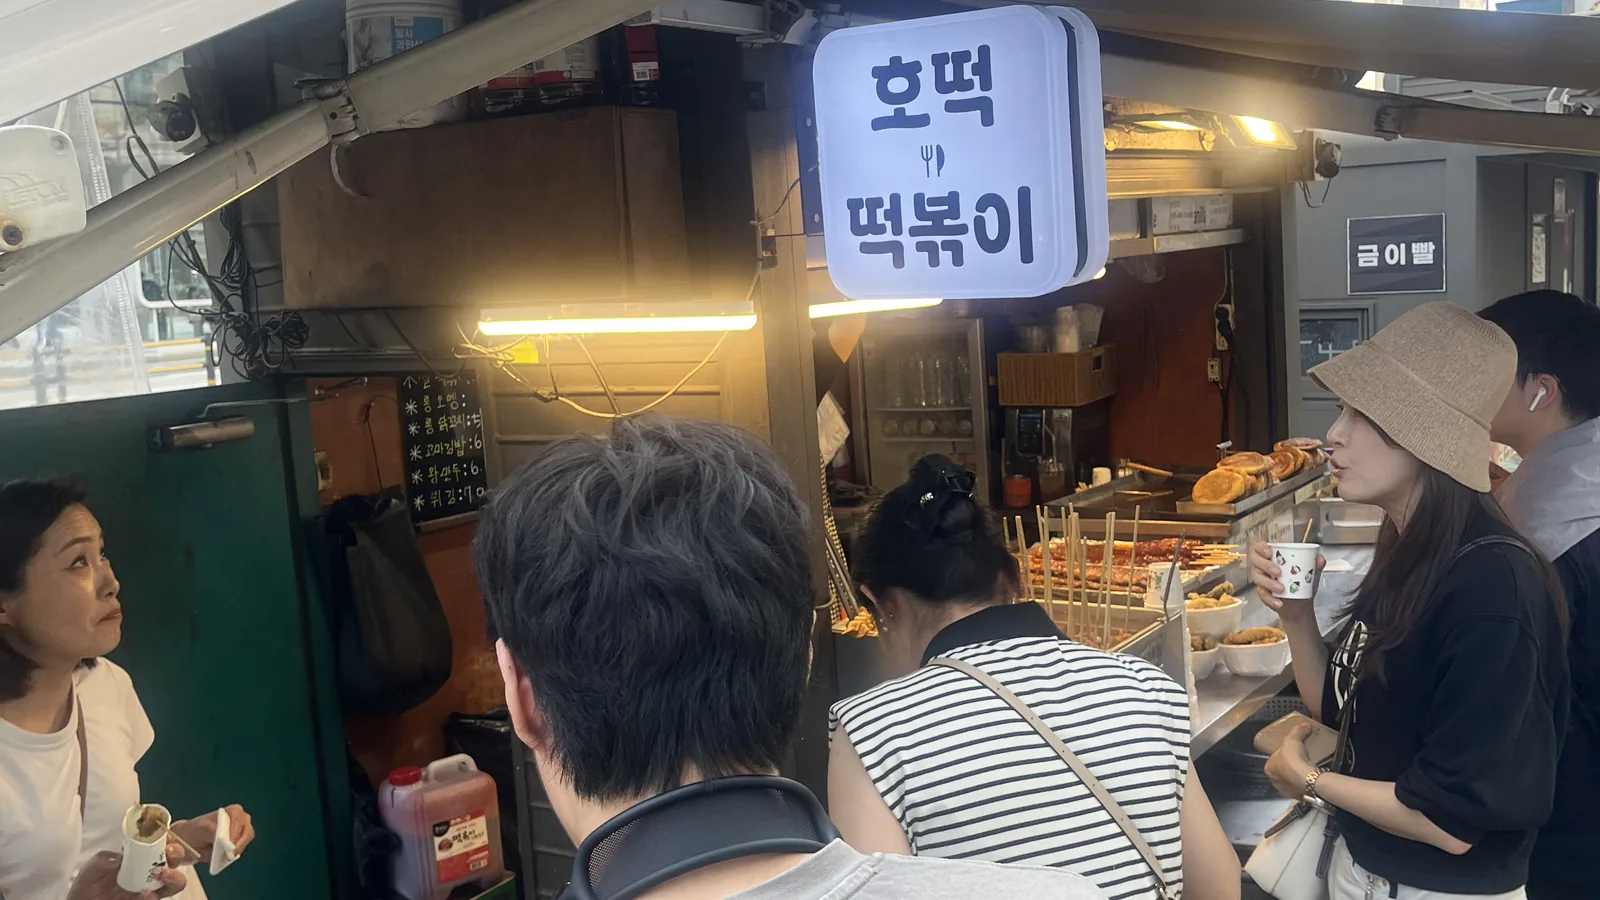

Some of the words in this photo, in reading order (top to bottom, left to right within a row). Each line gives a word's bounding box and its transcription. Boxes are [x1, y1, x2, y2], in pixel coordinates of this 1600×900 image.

[871, 44, 994, 131] 호떡
[847, 186, 1034, 269] 떡볶이
[1357, 241, 1436, 267] 금이빨
